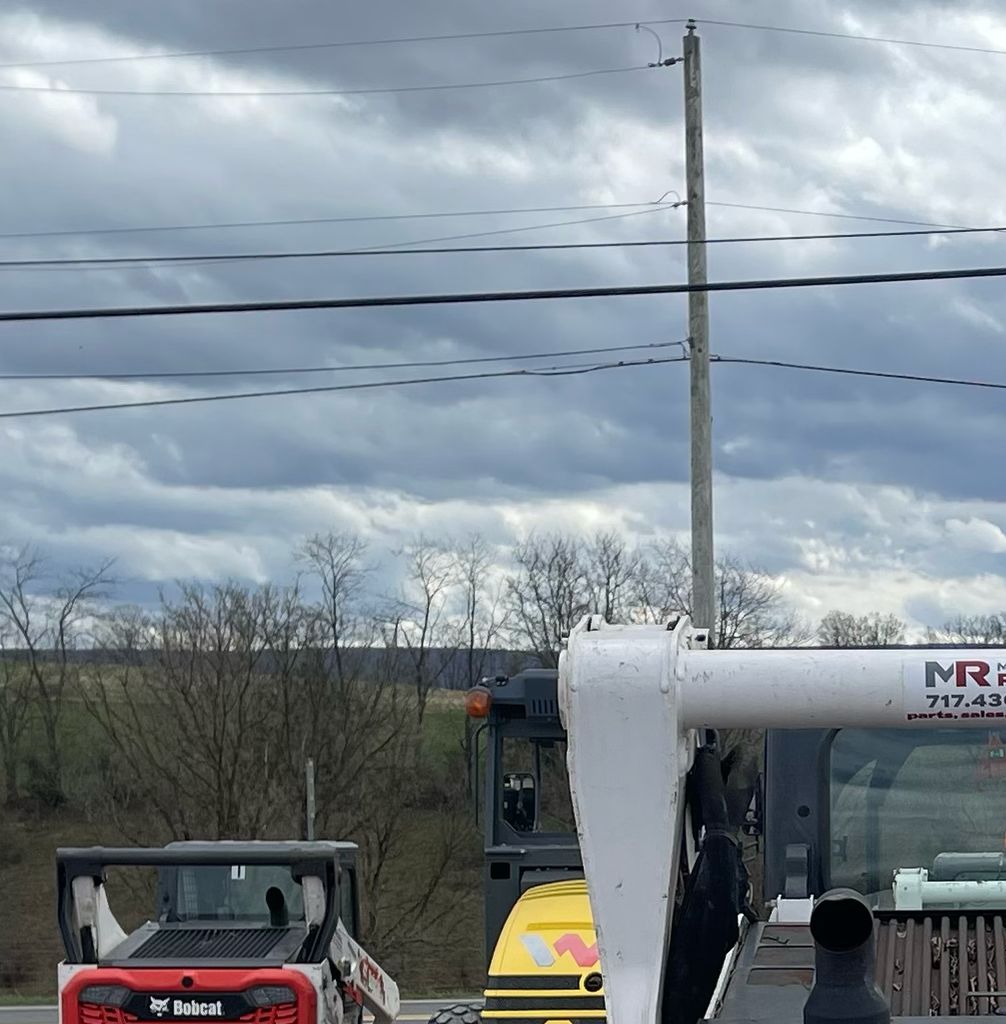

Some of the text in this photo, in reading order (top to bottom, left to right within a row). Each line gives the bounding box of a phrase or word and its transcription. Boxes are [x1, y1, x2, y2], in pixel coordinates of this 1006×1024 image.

[925, 661, 991, 687] MR
[907, 710, 958, 720] parts,
[173, 1000, 222, 1016] Bobcat
